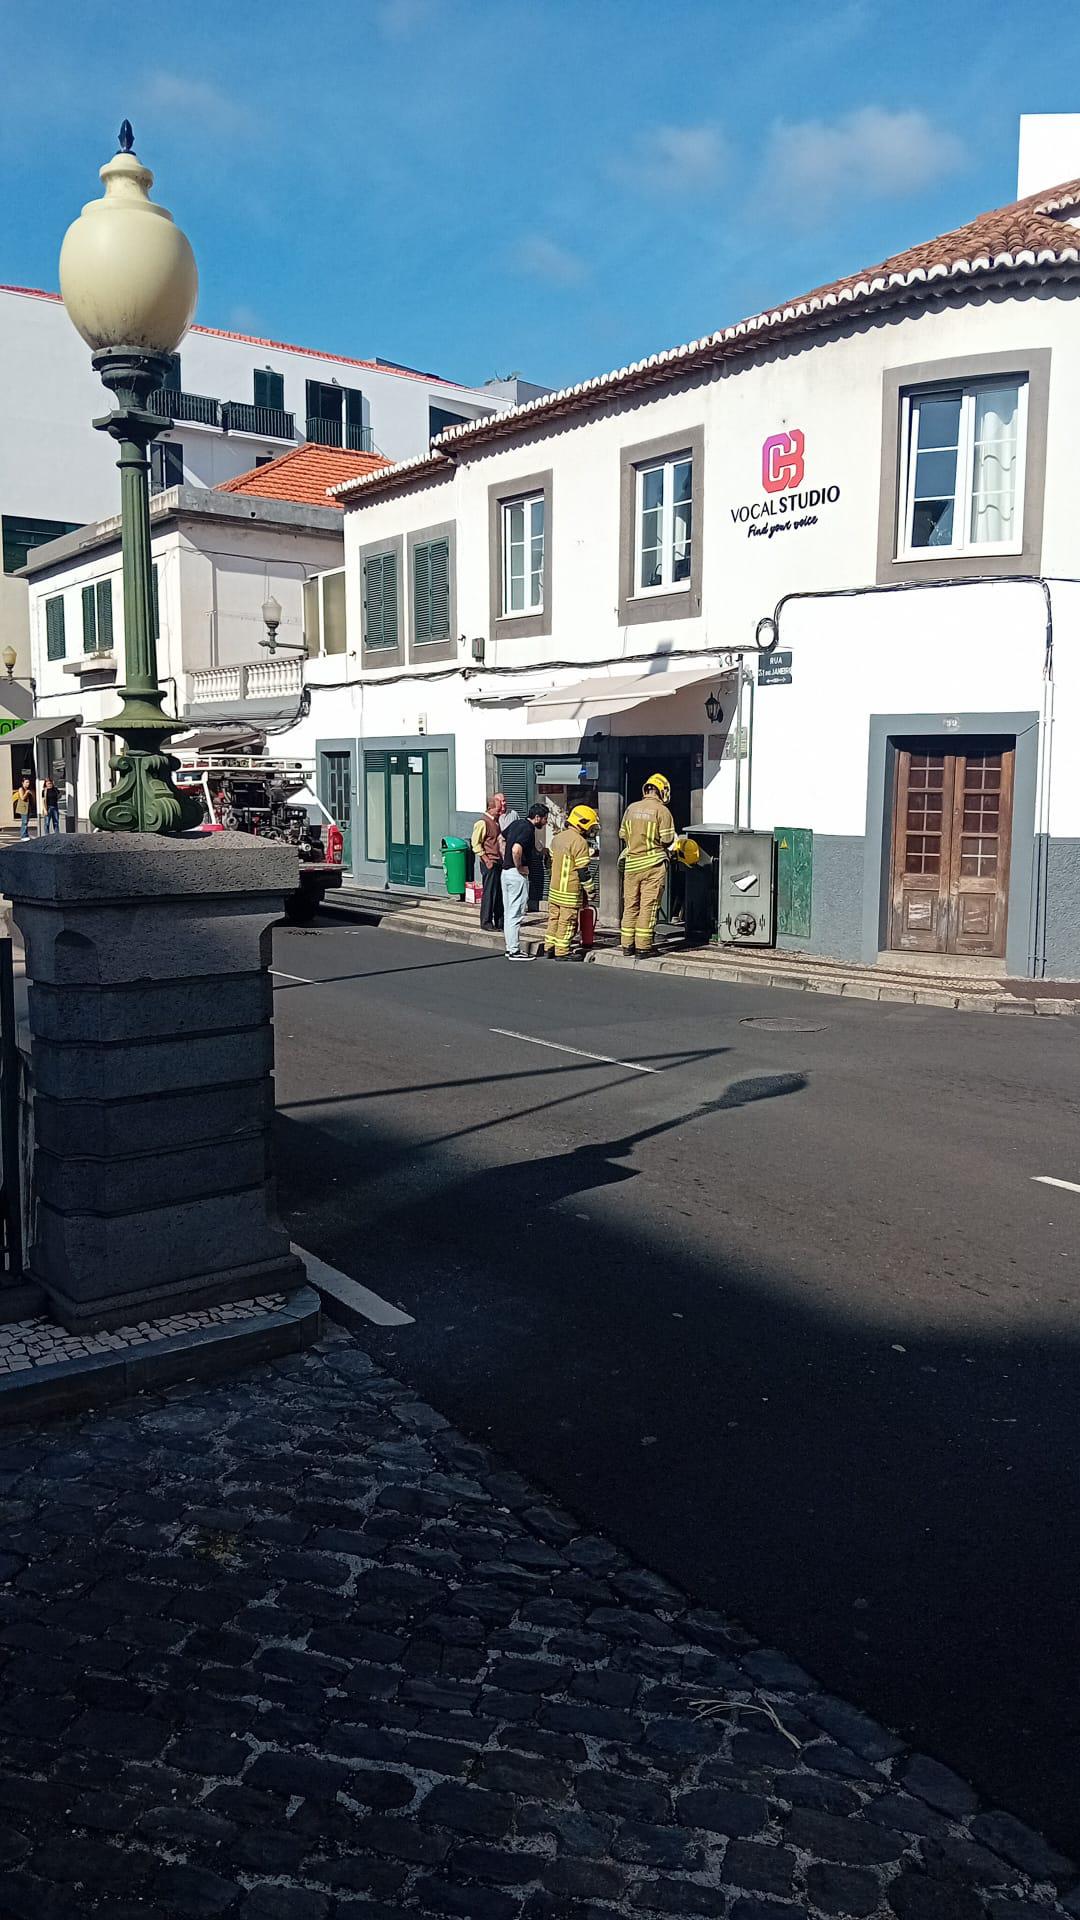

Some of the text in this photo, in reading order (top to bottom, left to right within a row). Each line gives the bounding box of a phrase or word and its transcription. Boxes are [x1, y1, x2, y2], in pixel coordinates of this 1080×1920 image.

[747, 516, 818, 539] Find your voice
[769, 656, 783, 665] RUA
